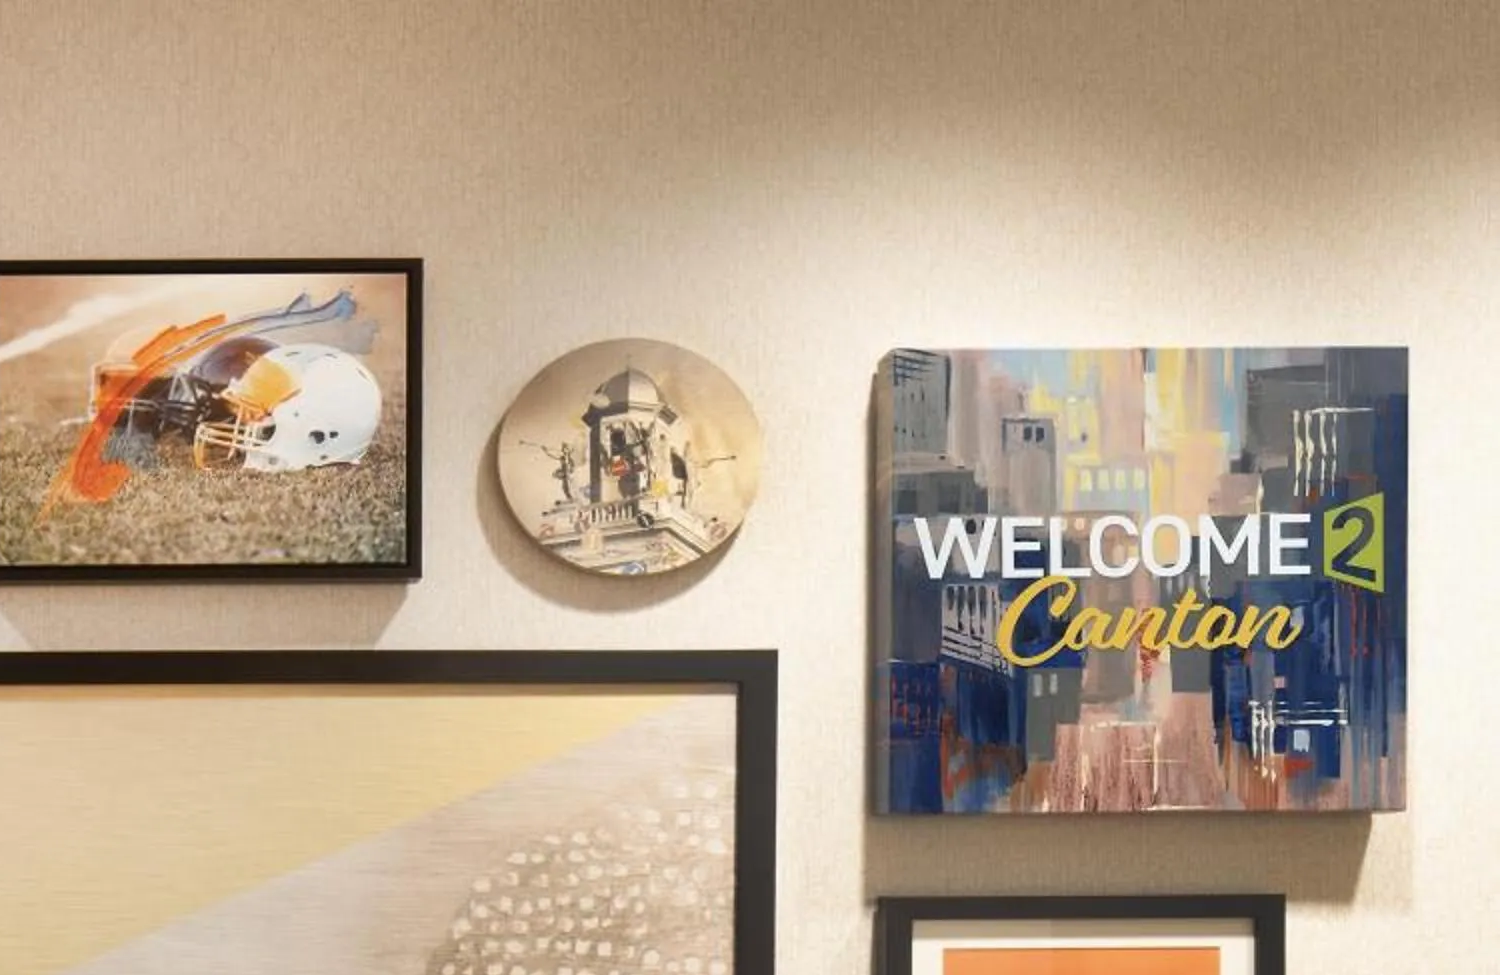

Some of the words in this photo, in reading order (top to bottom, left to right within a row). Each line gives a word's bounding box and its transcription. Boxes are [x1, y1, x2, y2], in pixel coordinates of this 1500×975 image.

[913, 513, 1311, 579] WELCOME
[1330, 506, 1378, 583] 2
[997, 575, 1303, 668] Canton
